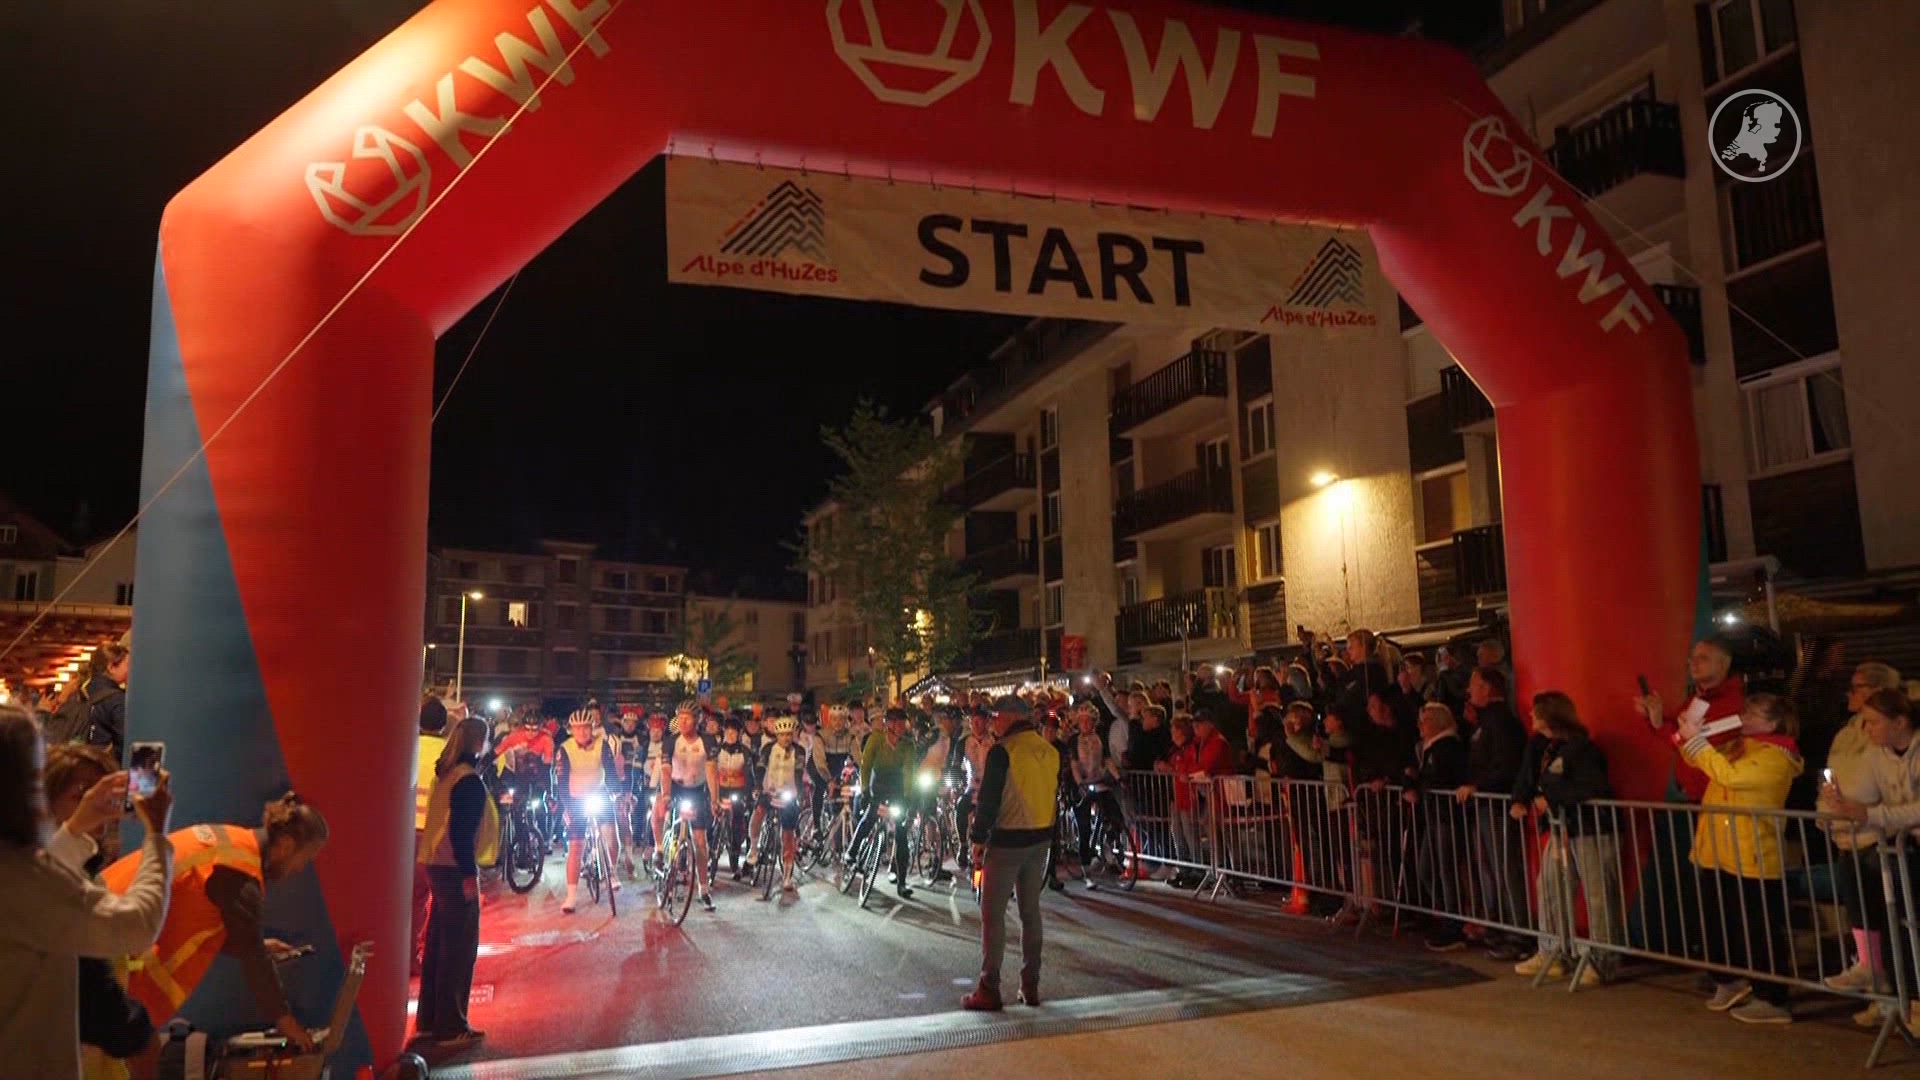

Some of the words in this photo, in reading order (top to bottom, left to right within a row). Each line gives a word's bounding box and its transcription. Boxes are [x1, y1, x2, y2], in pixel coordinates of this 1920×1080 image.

[403, 0, 611, 168] KWF
[1009, 0, 1320, 138] KWF
[682, 255, 744, 277] Alpe
[751, 260, 838, 283] d'HuZes
[917, 213, 1205, 307] START
[1260, 304, 1304, 326] Alpe
[1512, 184, 1654, 334] KWF
